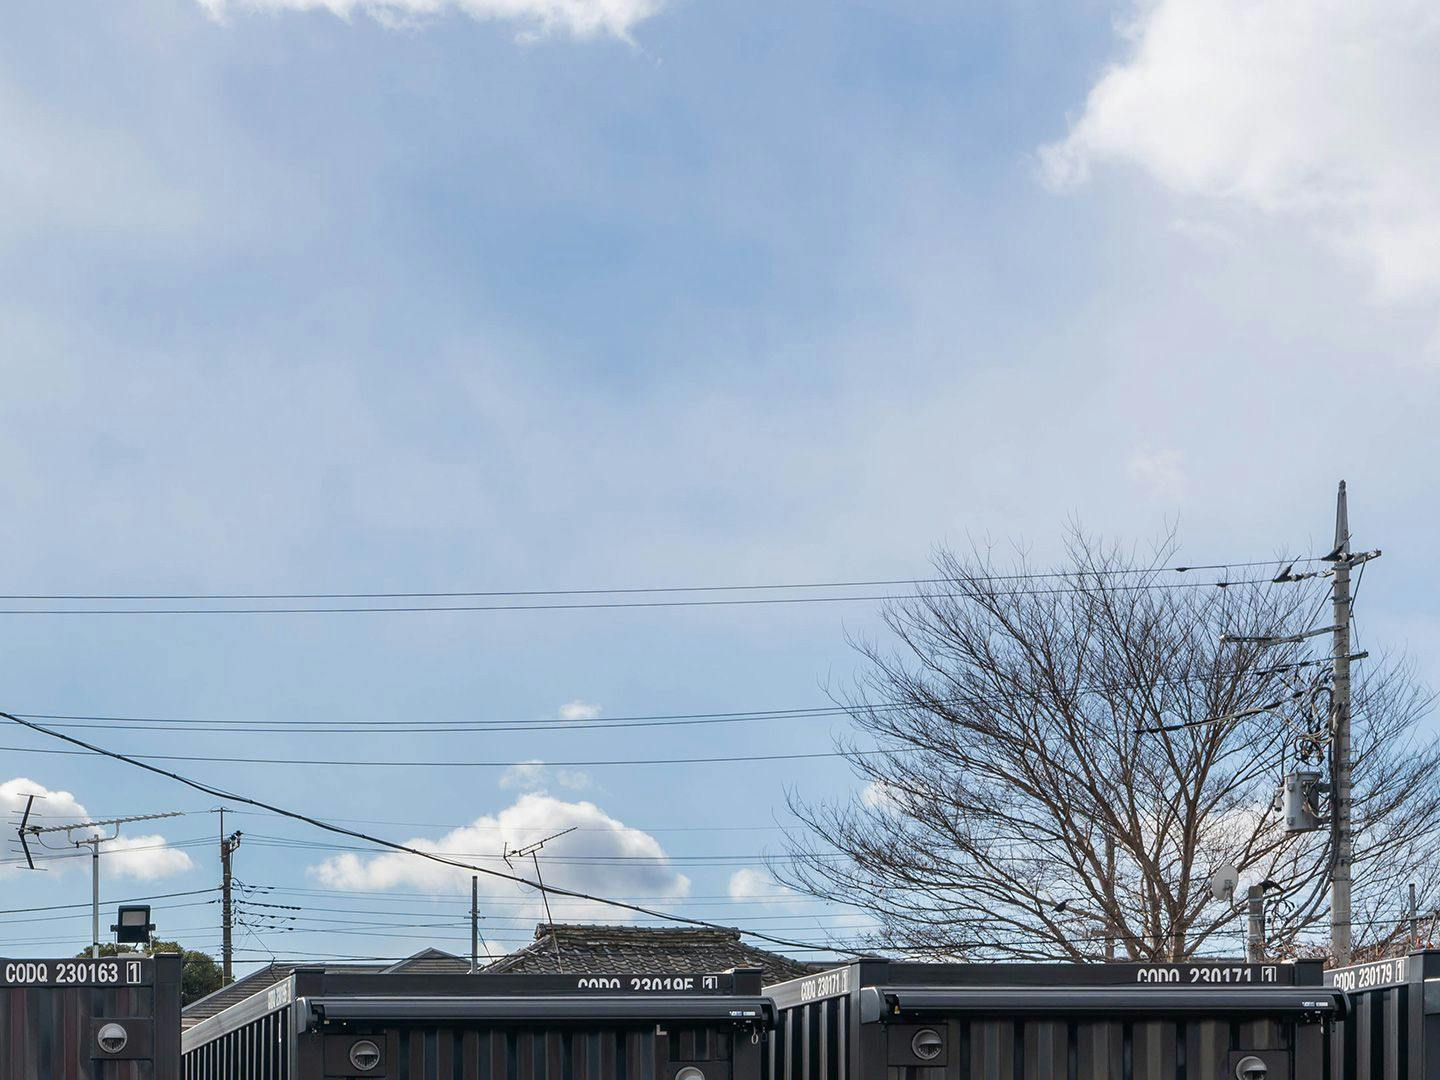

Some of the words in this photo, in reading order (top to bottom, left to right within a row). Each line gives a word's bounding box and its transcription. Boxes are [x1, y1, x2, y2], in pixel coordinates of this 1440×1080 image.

[6, 963, 48, 983] CODQ
[56, 963, 118, 983] 230163
[128, 962, 140, 983] 1
[1190, 968, 1251, 982] 230171
[1359, 963, 1392, 988] 230179
